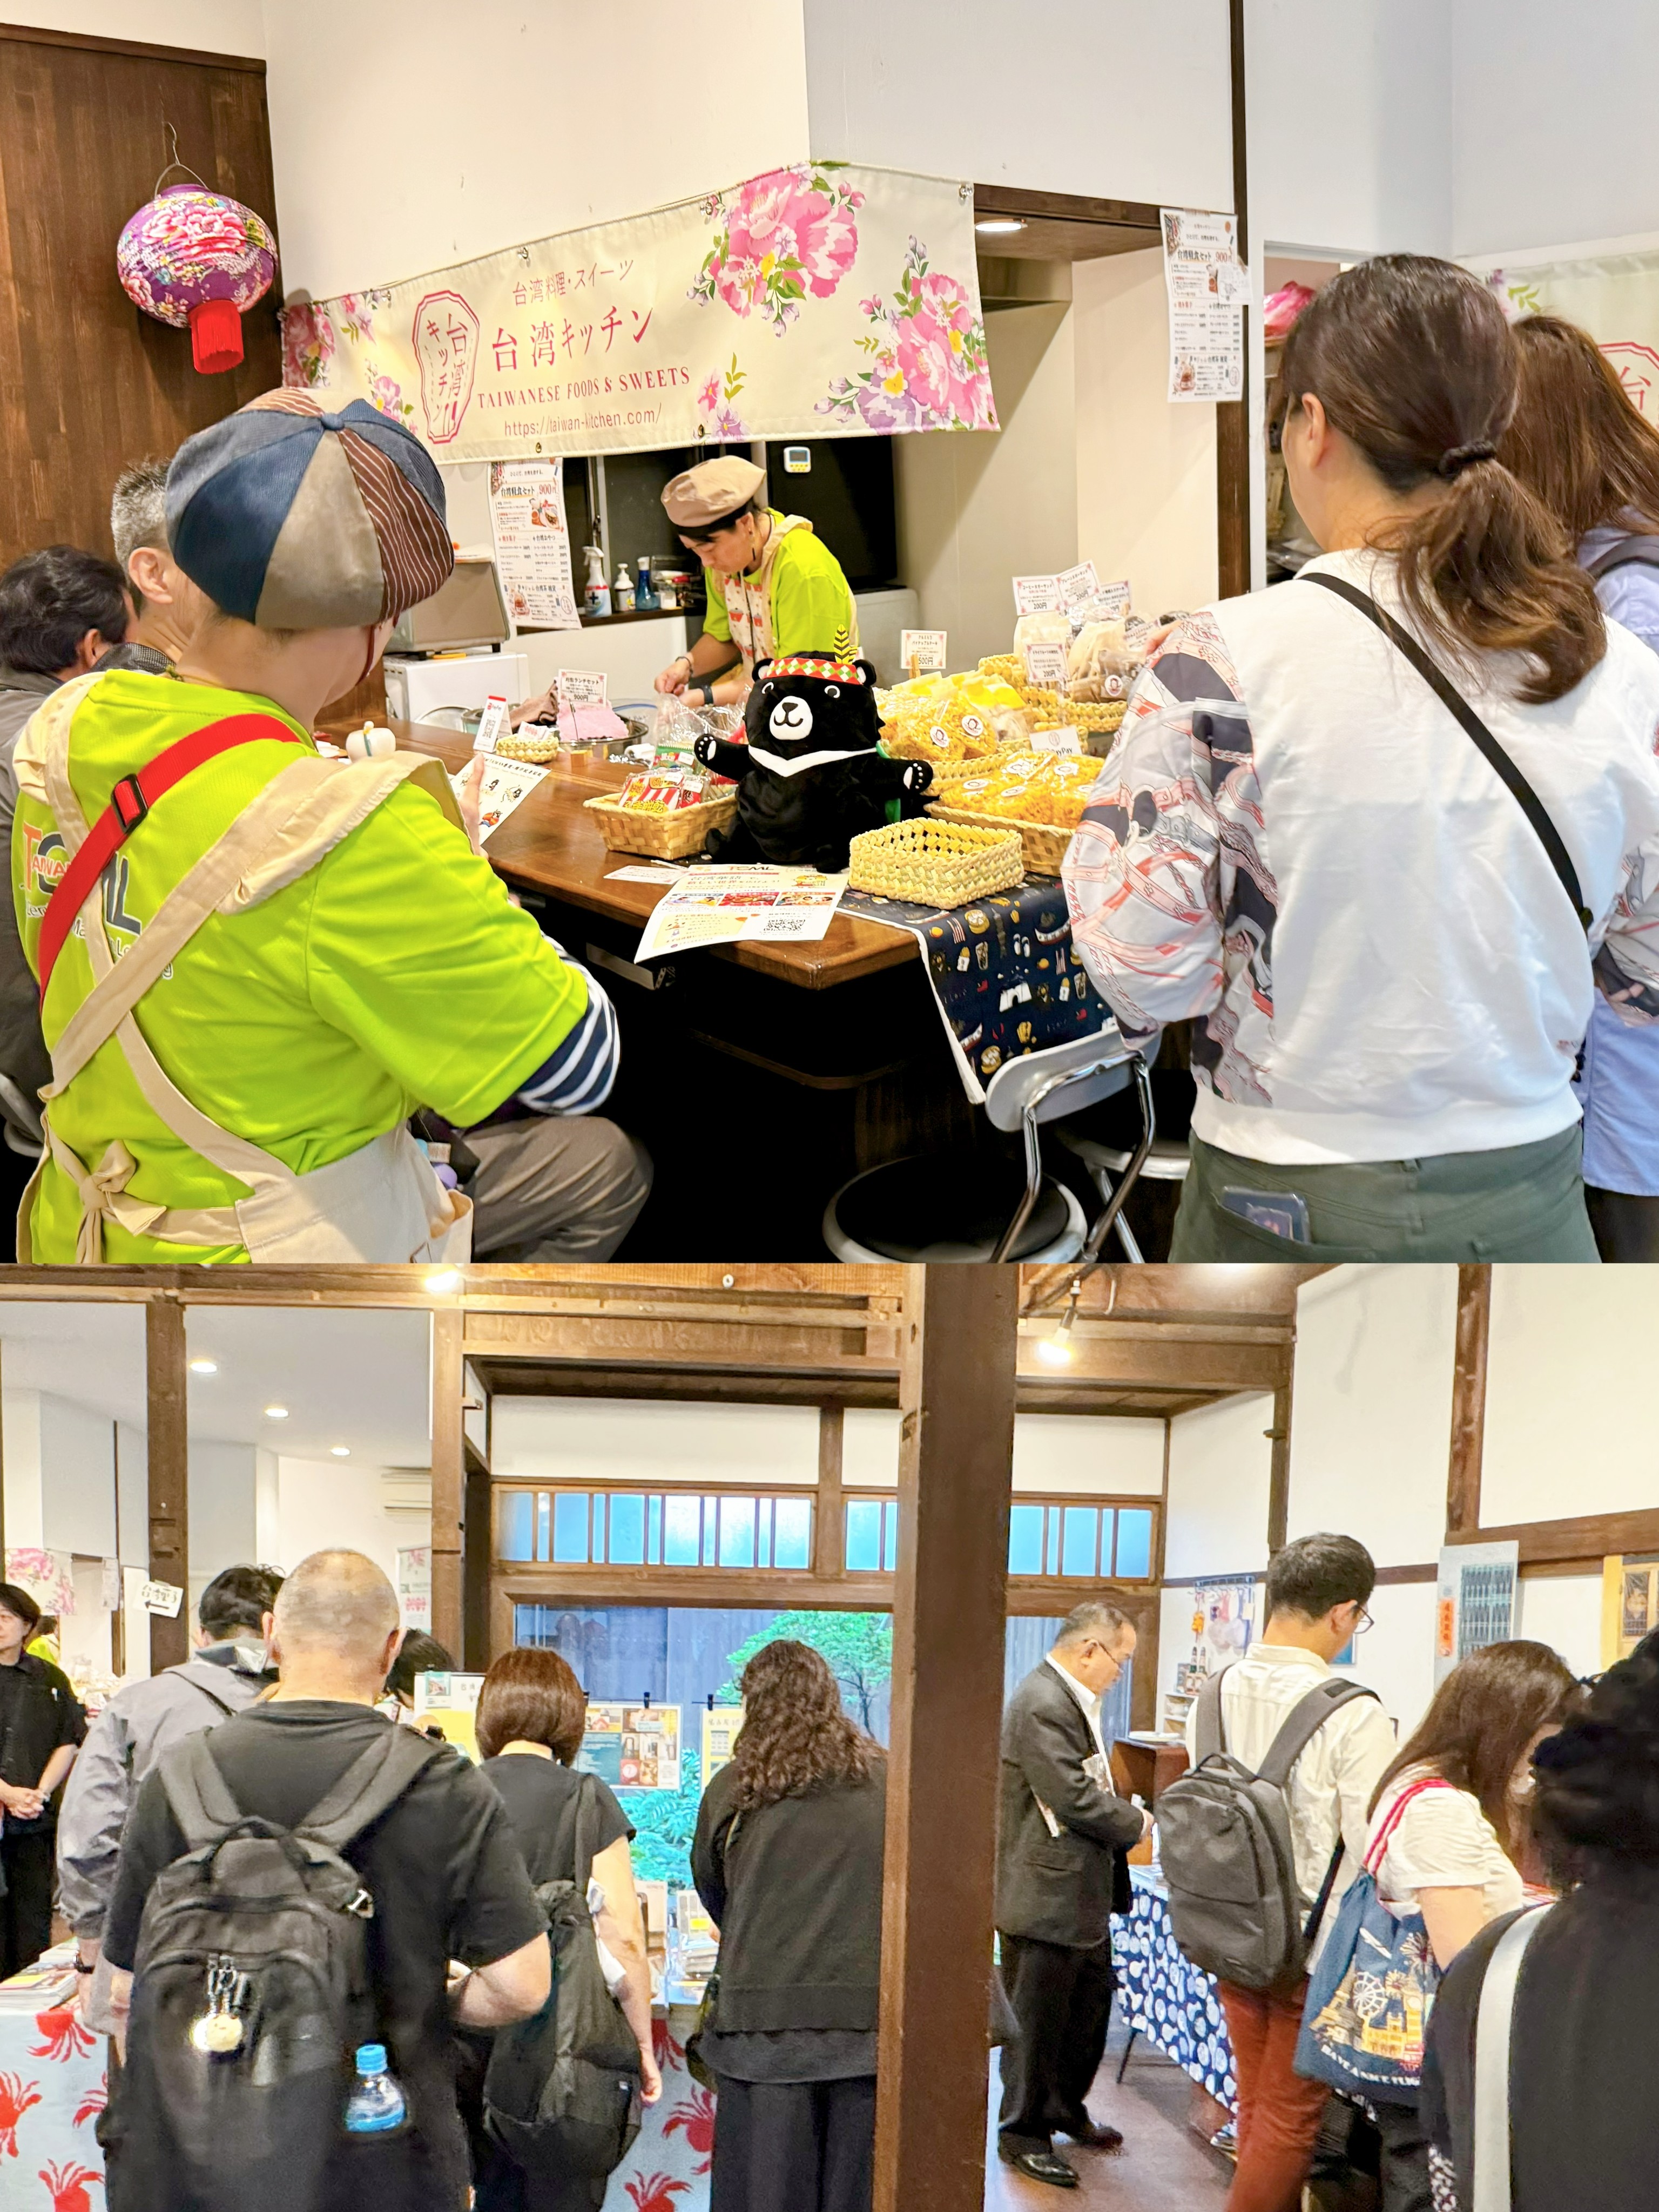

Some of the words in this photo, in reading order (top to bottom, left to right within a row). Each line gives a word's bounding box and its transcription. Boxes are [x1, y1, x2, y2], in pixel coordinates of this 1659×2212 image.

[512, 260, 633, 306] 台湾料理・スイーツ
[493, 306, 653, 372] 台湾キッチン
[478, 385, 560, 409] TAIWANESE
[568, 378, 599, 400] FOODS
[604, 376, 612, 393] &
[619, 366, 690, 392] SWEETS
[504, 402, 662, 438] https://taiwan-kitchen.com/
[574, 694, 588, 702] 900円
